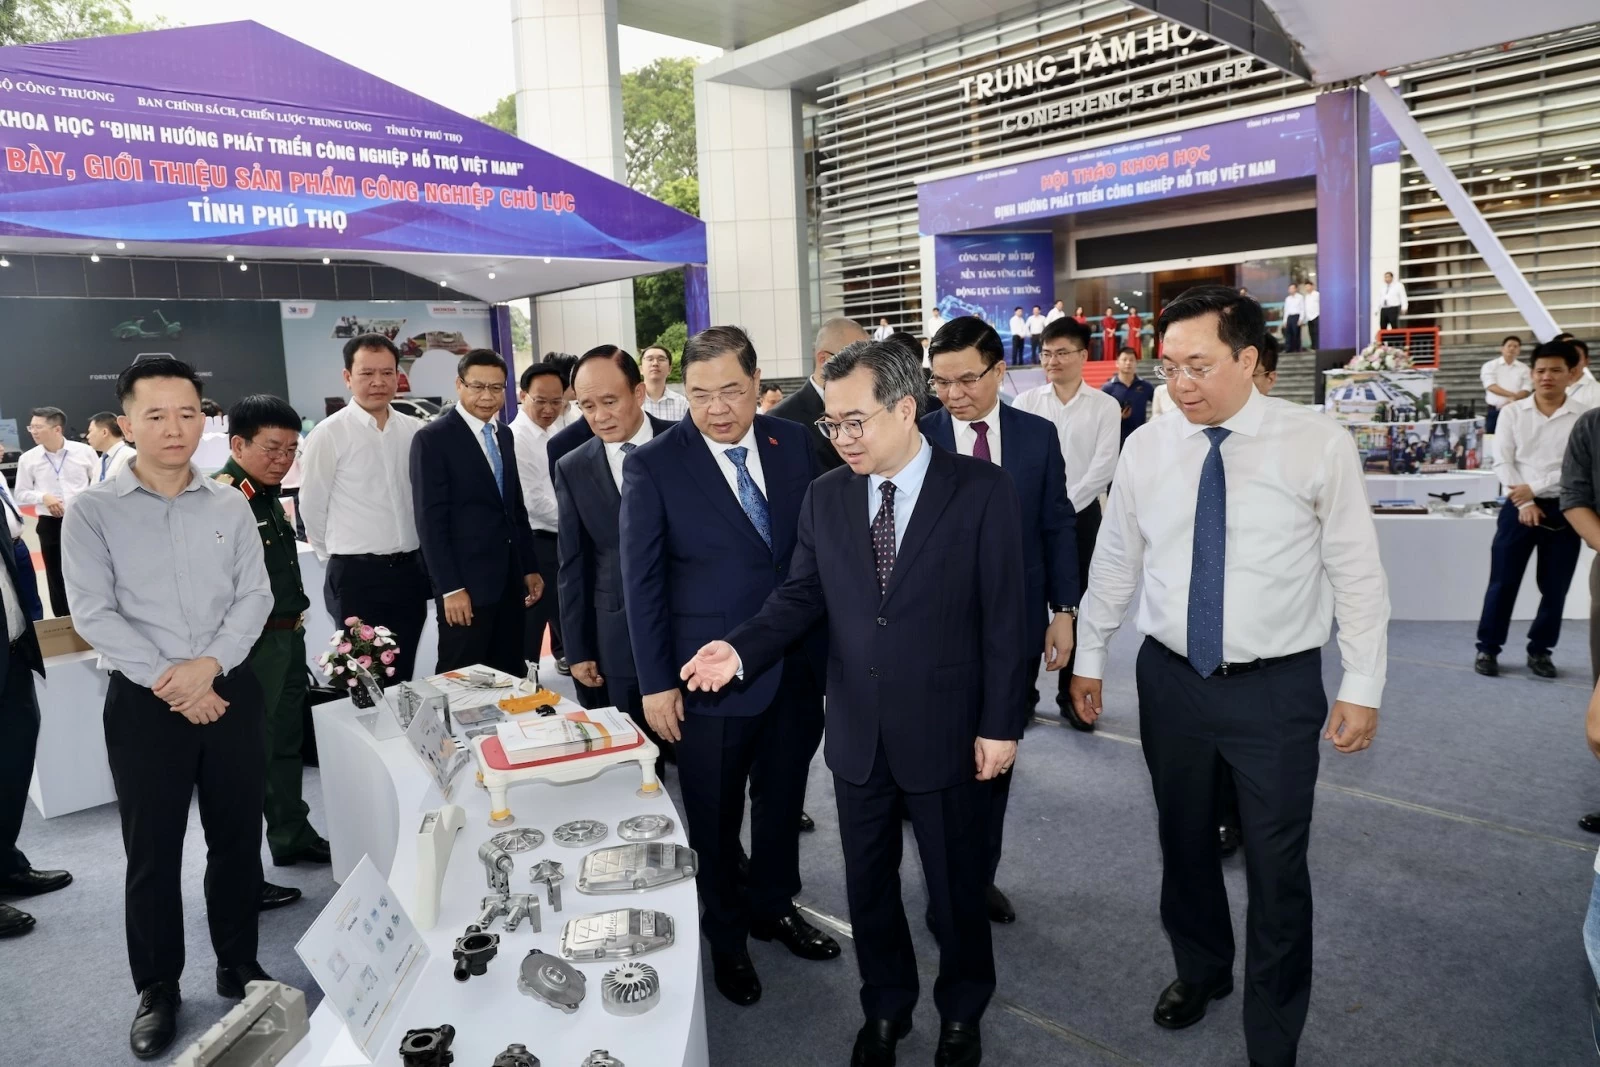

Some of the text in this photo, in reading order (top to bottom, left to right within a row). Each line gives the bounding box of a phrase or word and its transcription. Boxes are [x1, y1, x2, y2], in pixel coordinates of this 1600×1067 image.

[16, 81, 56, 96] CÔNG
[59, 87, 115, 103] THƯƠNG
[959, 55, 1057, 102] TRUNG
[1068, 31, 1136, 74] TÂM
[1002, 58, 1253, 133] CONFERENCE CENTER
[138, 96, 372, 132] BAN CHÍNH SÁCH, CHIẾN LƯỢC TRUNG ƯƠNG
[53, 115, 95, 138] HỌC
[100, 120, 155, 143] “ĐỊNH
[161, 126, 219, 149] HƯỚNG
[223, 132, 263, 153] PHÁT
[267, 134, 312, 157] TRIỂN
[316, 140, 355, 162] CÔNG
[359, 147, 408, 169] NGHIỆP
[412, 148, 430, 169] HỖ
[433, 155, 458, 173] TRỢ
[461, 155, 488, 176] VIỆT
[491, 159, 524, 177] NAM”
[1041, 144, 1211, 191] HỘI THẢO KHOA HỌC
[5, 142, 576, 215] BÀY, GIỚI THIỆU SẢN PHẨM CÔNG NGHIỆP CHỦ LỰC
[994, 159, 1276, 220] ĐỊNH HƯỚNG PHÁT TRIỂN CÔNG NGHIỆP HỖ TRỢ VIỆT NAM
[188, 196, 347, 233] TỈNH PHÚ THỌ
